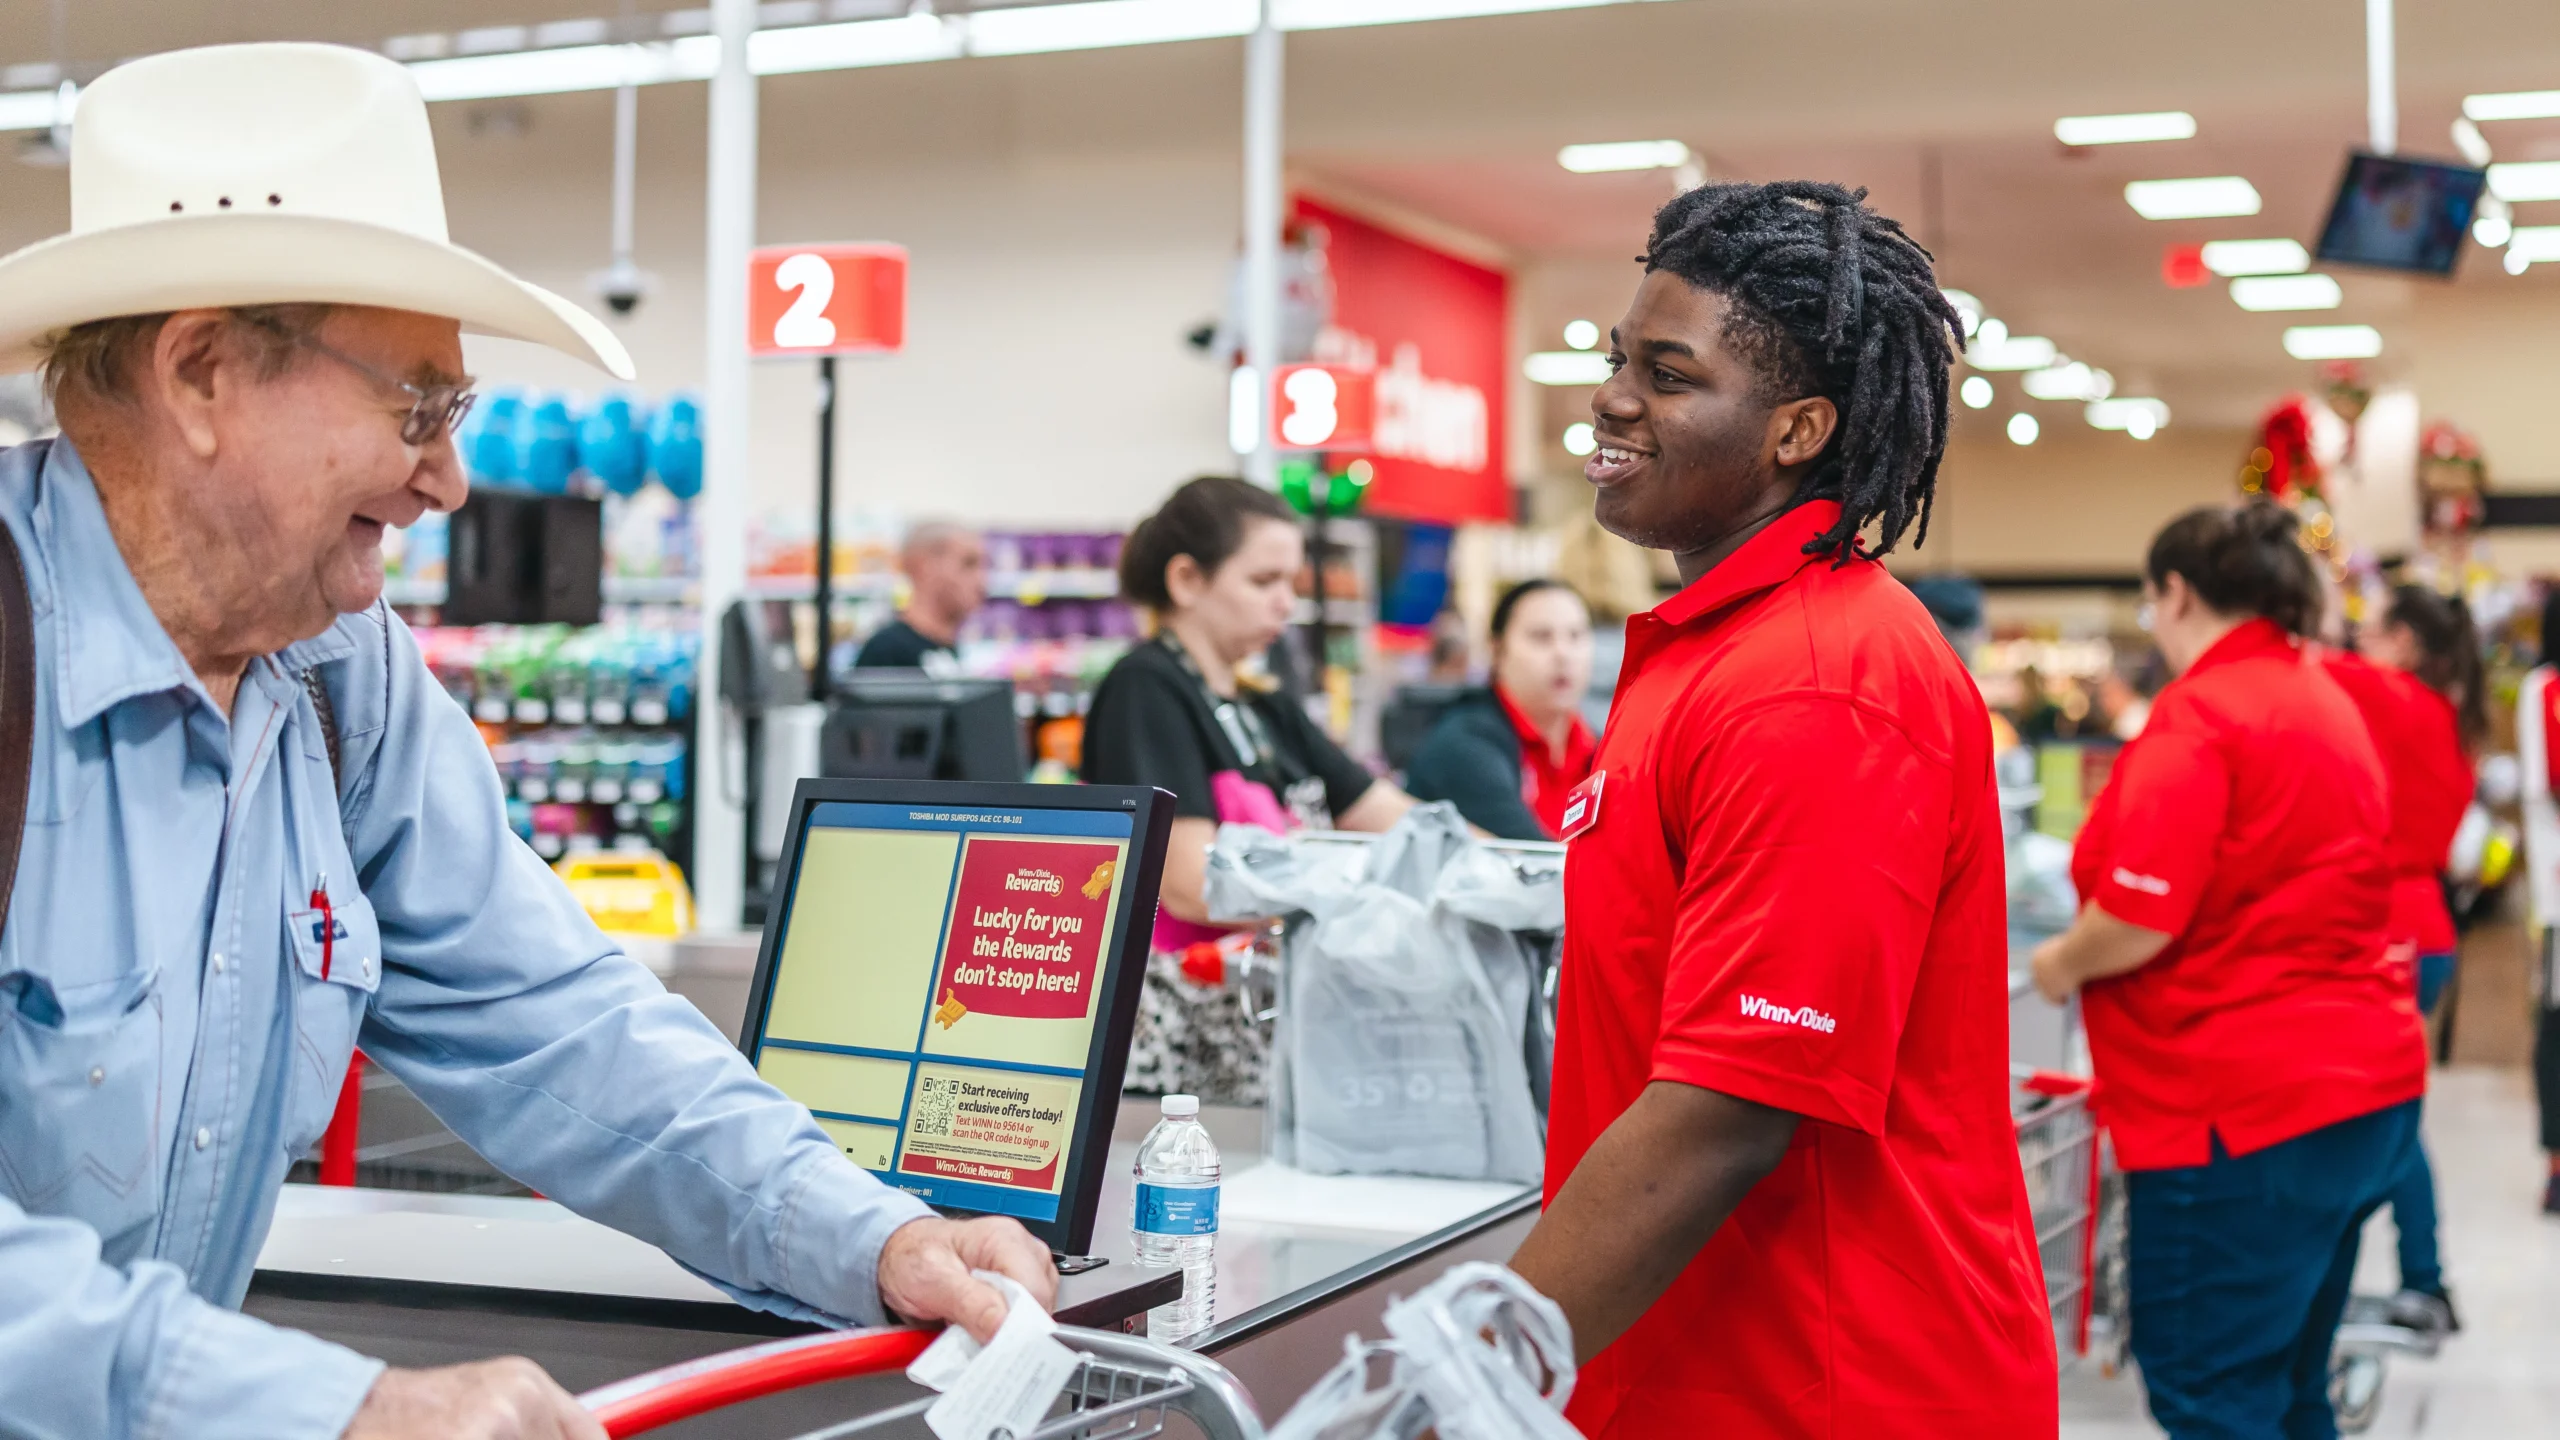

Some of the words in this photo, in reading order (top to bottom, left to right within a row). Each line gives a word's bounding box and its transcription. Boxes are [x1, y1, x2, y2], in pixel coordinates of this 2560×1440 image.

[774, 253, 836, 348] 2
[1282, 367, 1337, 446] 3
[909, 812, 934, 820] TOSHIBA
[934, 813, 949, 821] MOD
[951, 813, 979, 822] SUREPOS
[979, 814, 992, 823] ACE
[992, 815, 1002, 823] CC
[973, 905, 1022, 936] Lucky
[1023, 907, 1050, 931] for
[1049, 916, 1082, 939] you
[972, 934, 1000, 957] the
[1001, 936, 1072, 963] Rewards
[953, 961, 996, 986] don't
[997, 967, 1034, 995] stop
[1035, 967, 1080, 993] here!
[961, 1082, 985, 1097] Start
[986, 1087, 1029, 1104] receiving
[955, 1115, 970, 1126] Text
[972, 1117, 993, 1129] WINN
[994, 1120, 1001, 1130] to
[1003, 1121, 1024, 1132] 95614
[1025, 1125, 1034, 1134] or
[958, 1100, 1000, 1115] exclusive
[1001, 1103, 1030, 1119] offers
[1032, 1107, 1063, 1125] today!
[952, 1129, 969, 1138] scan
[969, 1129, 983, 1140] the
[983, 1131, 995, 1143] QR
[995, 1133, 1012, 1144] code
[1013, 1136, 1022, 1146] to
[1022, 1136, 1039, 1149] sign
[1039, 1140, 1050, 1150] up
